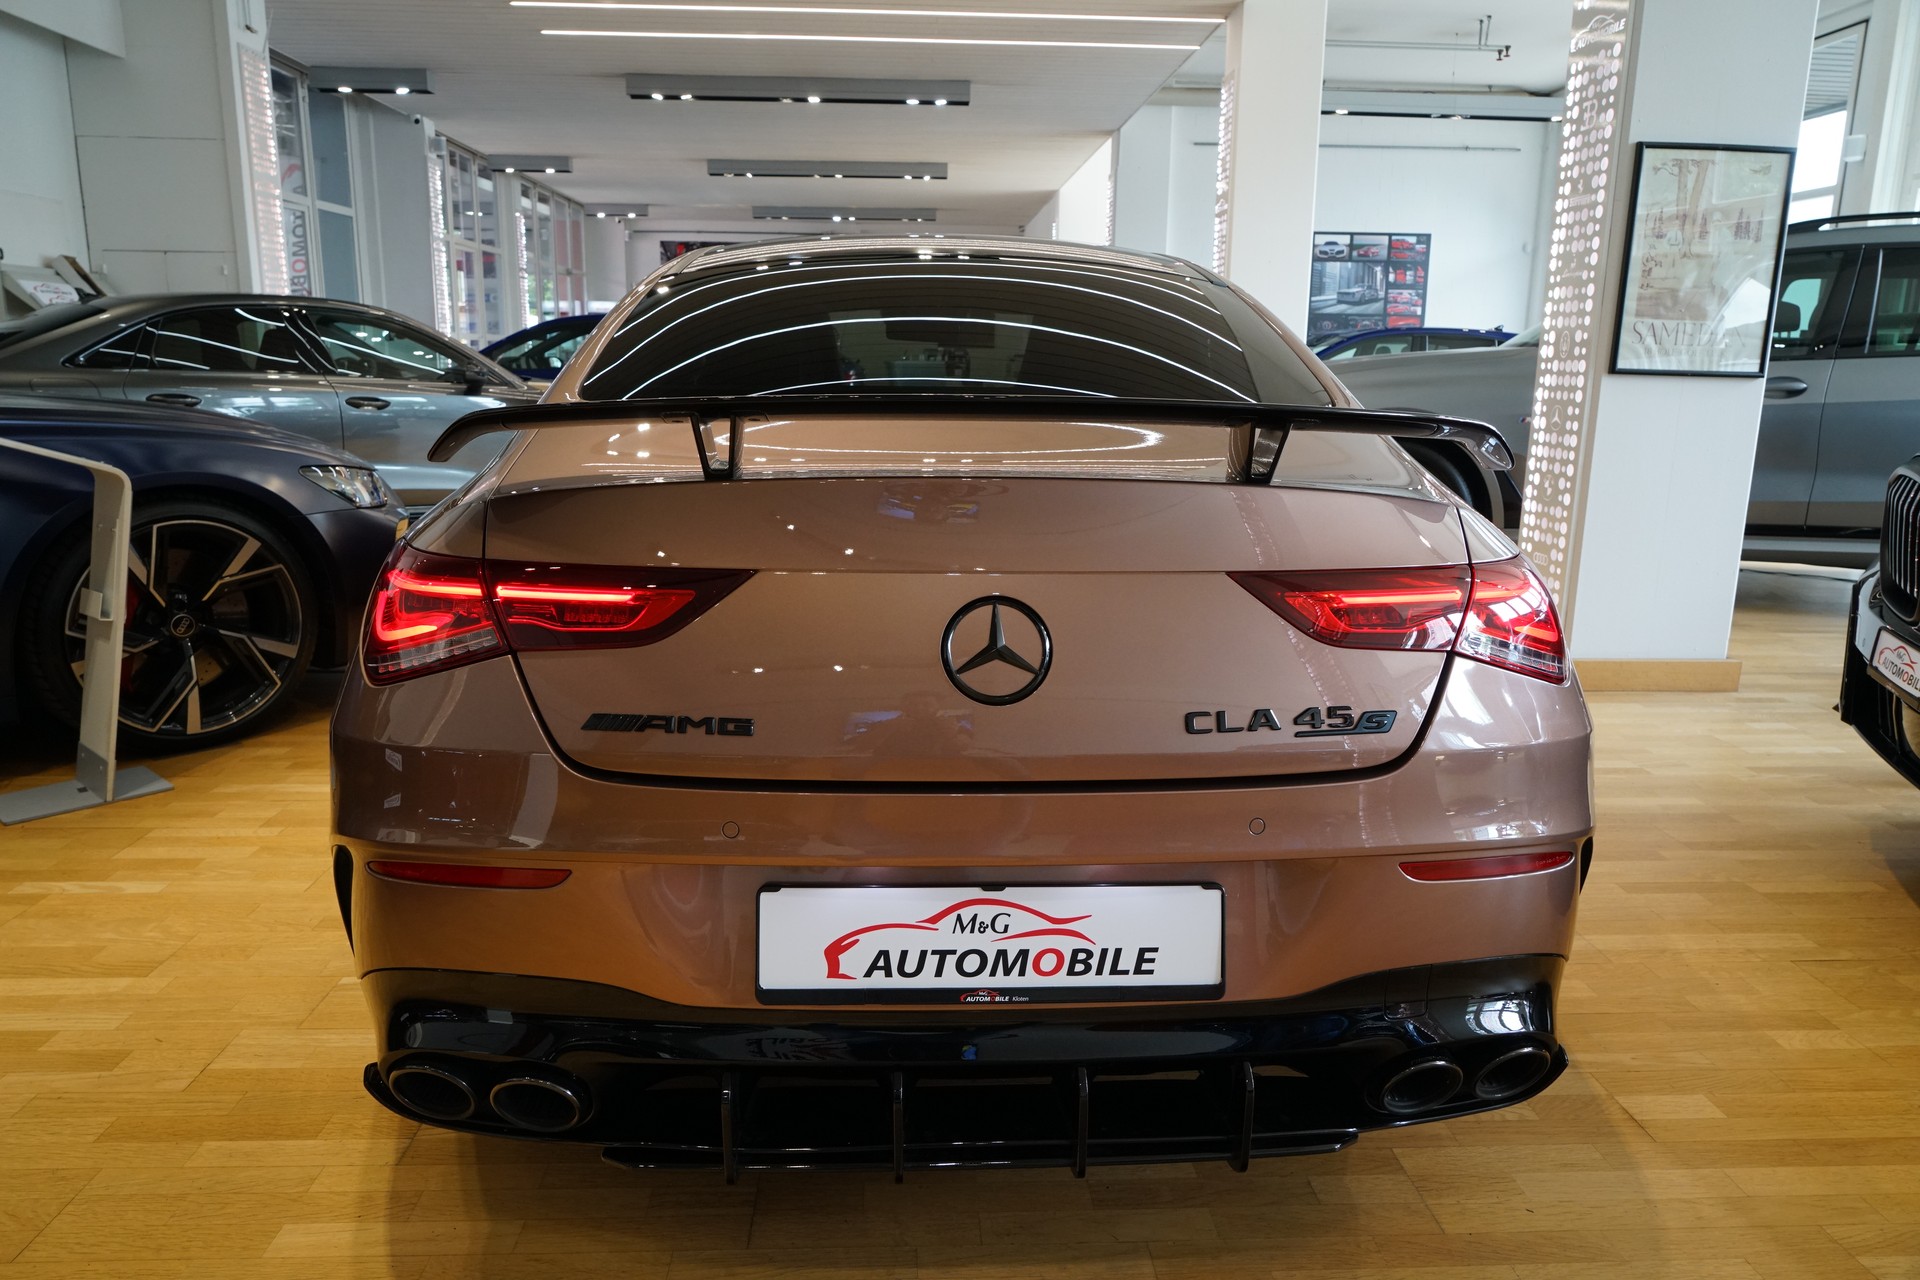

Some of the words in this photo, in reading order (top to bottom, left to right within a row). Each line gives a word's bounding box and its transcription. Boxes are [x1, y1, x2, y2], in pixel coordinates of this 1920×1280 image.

[1882, 656, 1920, 692] AUTOMOBIL
[633, 715, 755, 737] AMG
[1184, 708, 1282, 735] CLA
[952, 912, 1011, 935] M&G
[863, 946, 1160, 978] AUTOMOBILE
[965, 995, 1010, 1003] AUTOMOBILE
